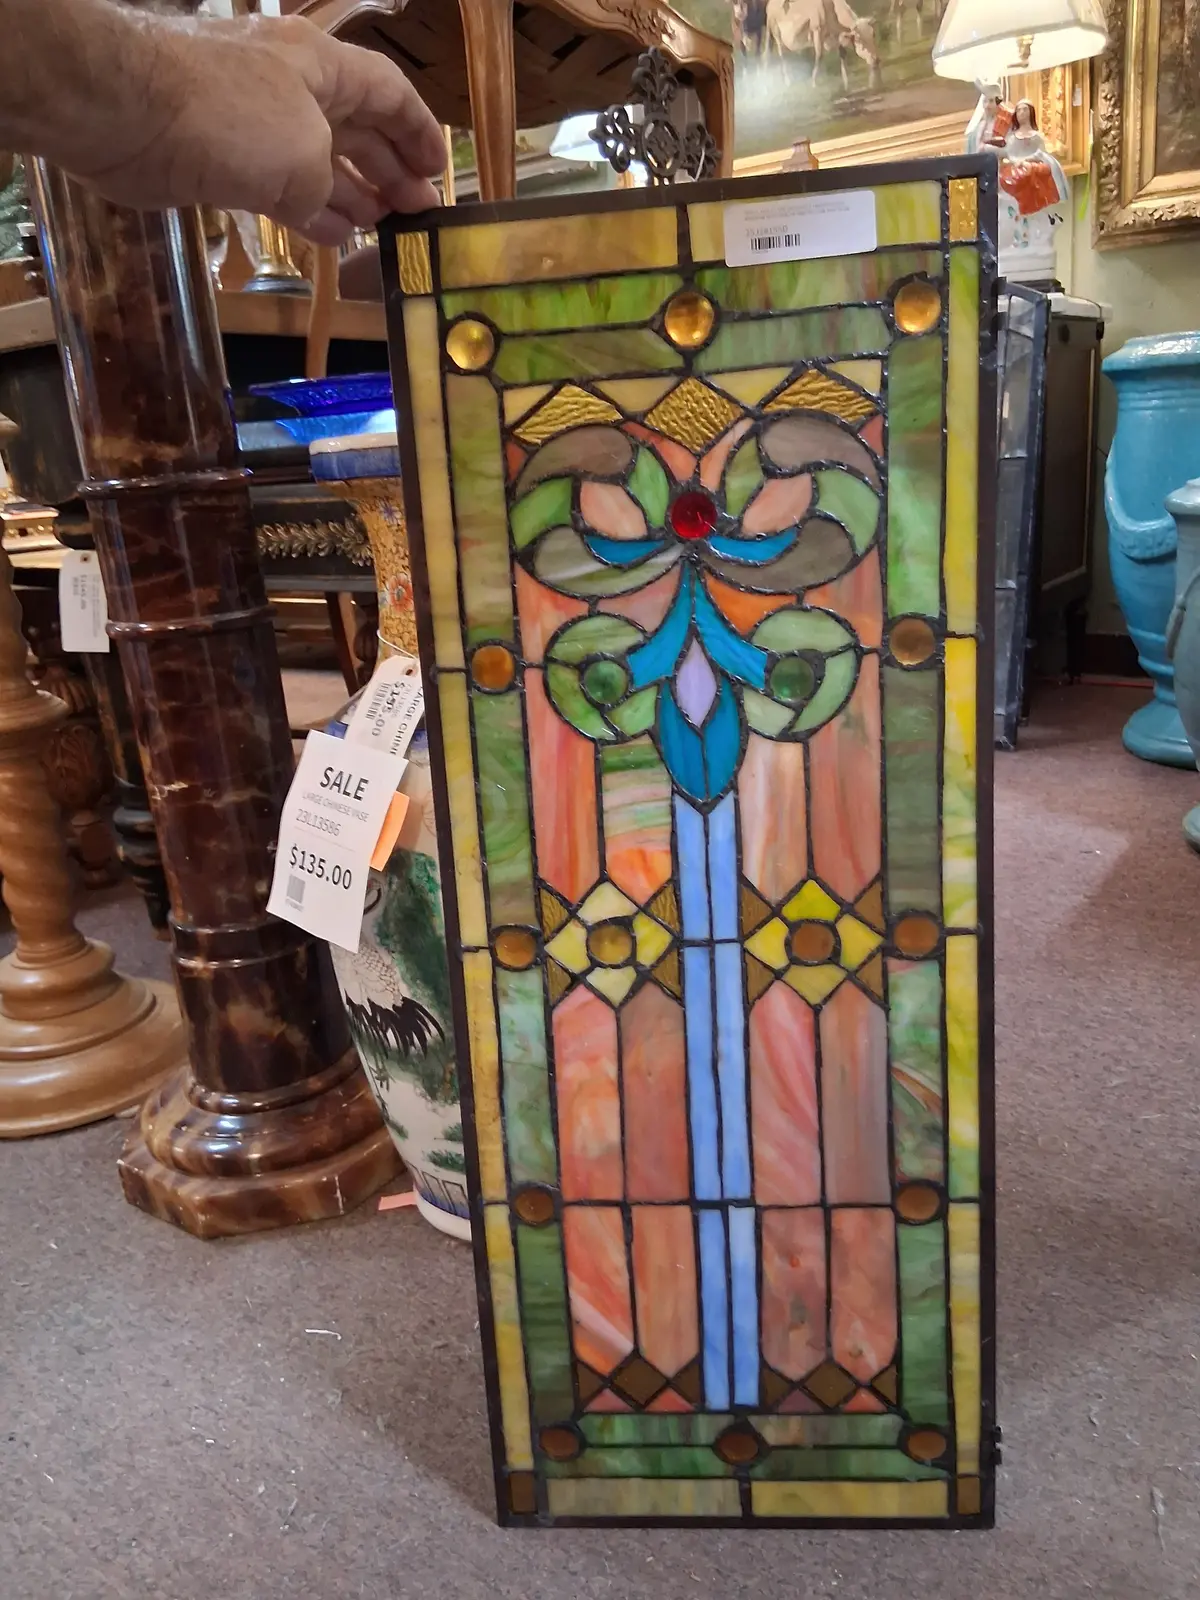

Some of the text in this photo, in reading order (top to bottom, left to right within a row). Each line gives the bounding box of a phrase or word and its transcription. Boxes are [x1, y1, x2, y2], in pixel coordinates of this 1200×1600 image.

[319, 766, 369, 801] SALE
[302, 791, 370, 823] LARGE CHINESE VASE
[289, 843, 353, 891] $135.00
